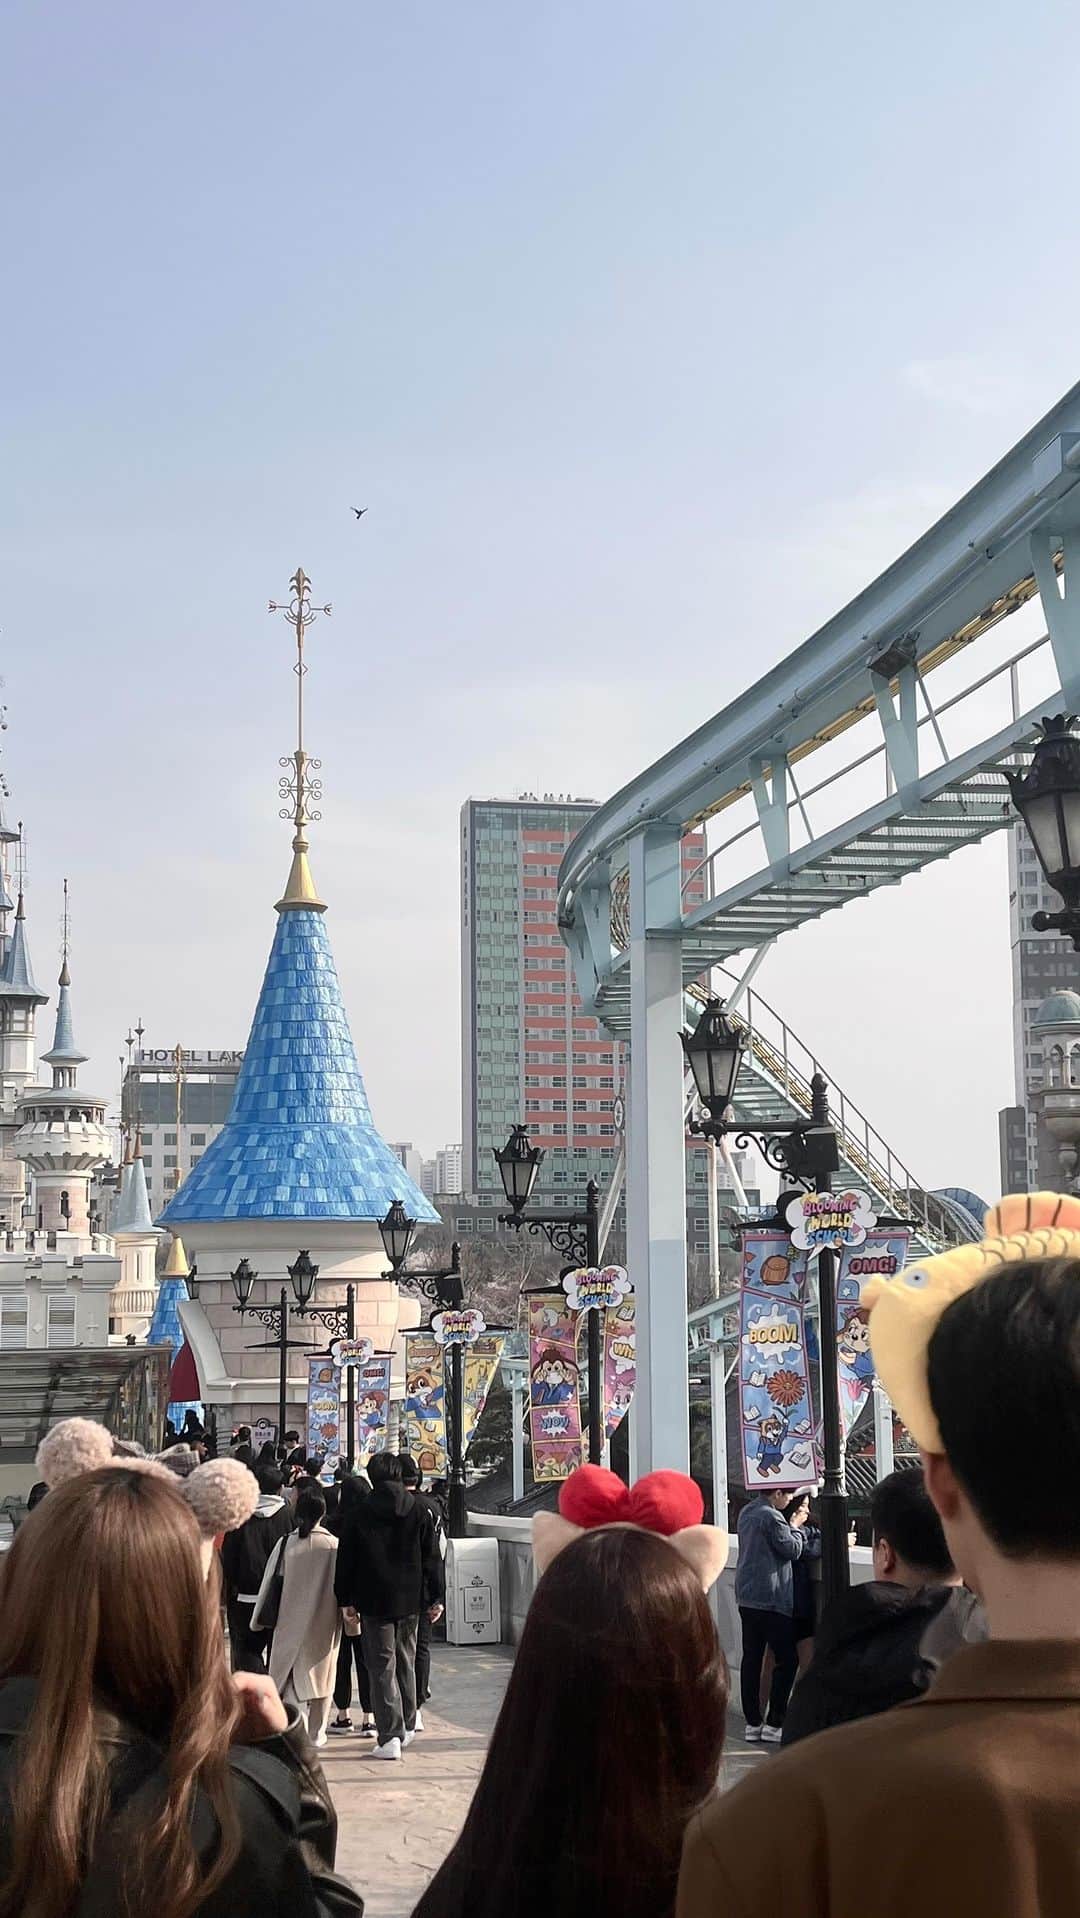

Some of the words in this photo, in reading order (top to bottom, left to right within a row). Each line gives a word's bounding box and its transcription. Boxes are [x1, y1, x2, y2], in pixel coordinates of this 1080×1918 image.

[142, 1050, 202, 1061] HOTEL
[803, 1199, 857, 1216] BLOOMING
[810, 1213, 853, 1229] WORLD
[848, 1256, 897, 1275] OMG!
[749, 1323, 798, 1344] BOOM
[542, 1415, 570, 1430] WOW
